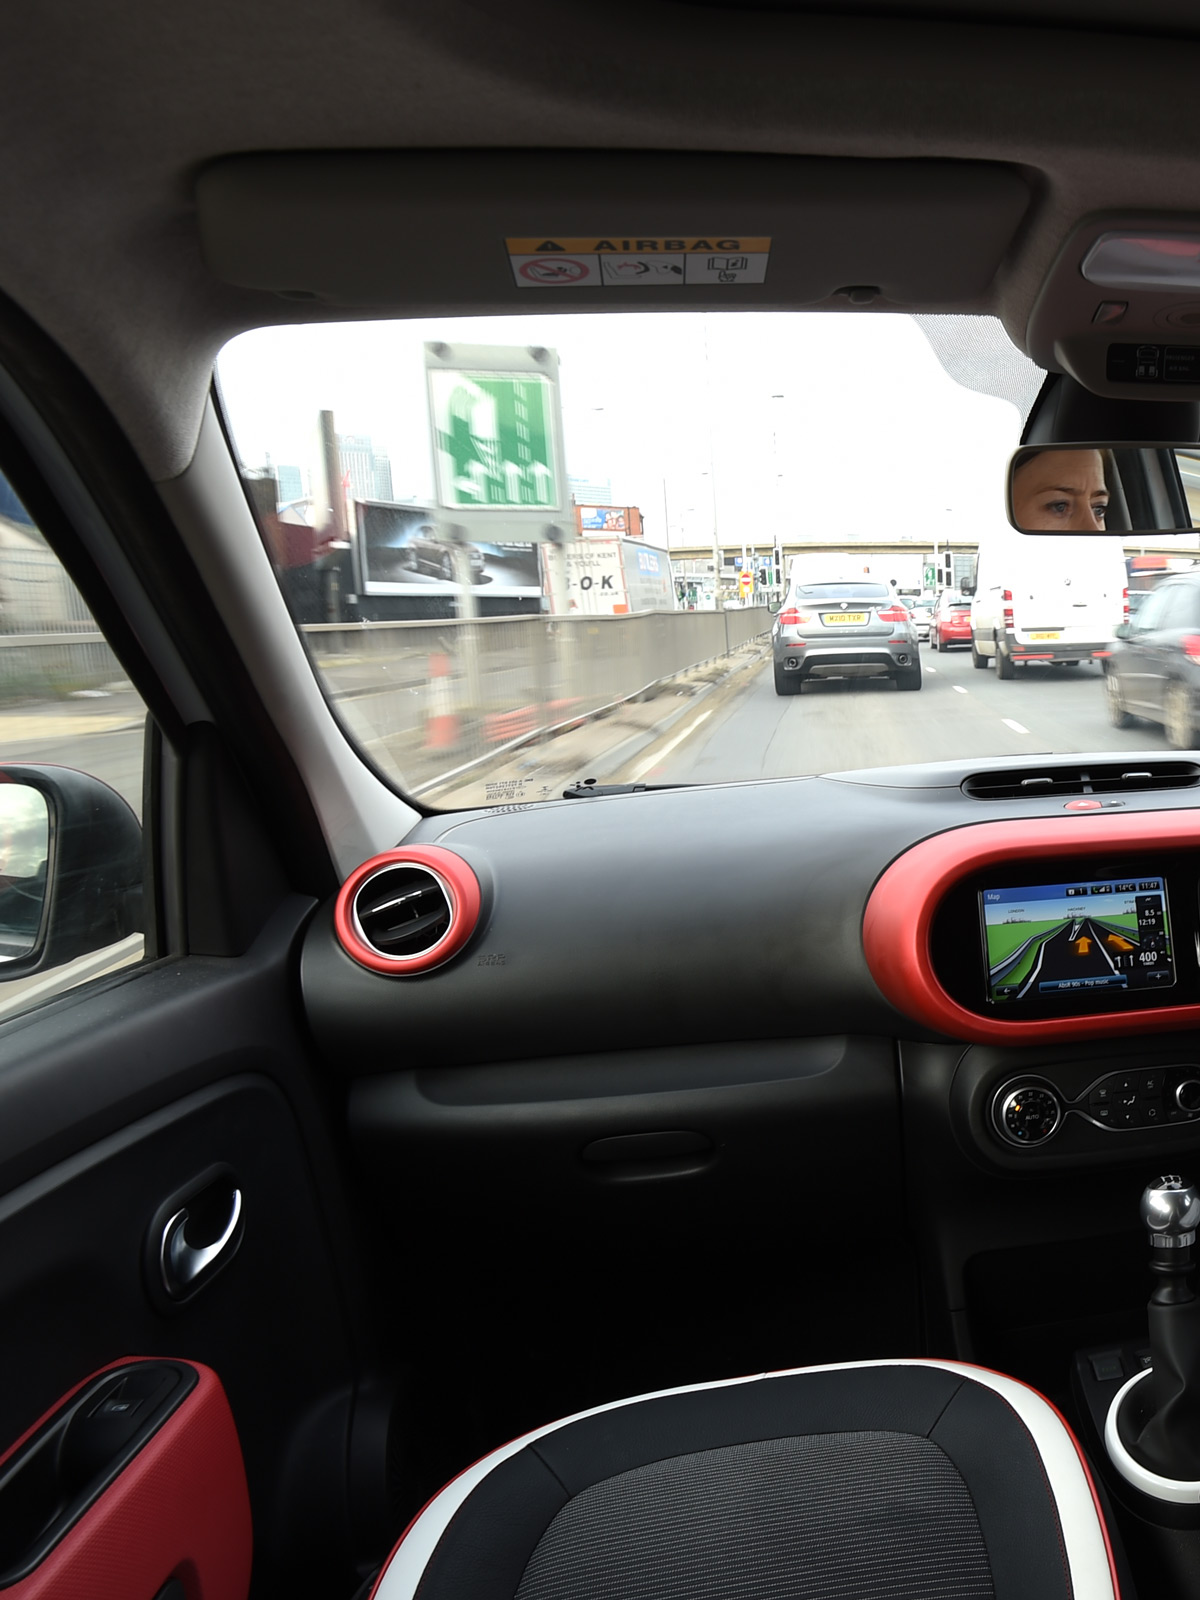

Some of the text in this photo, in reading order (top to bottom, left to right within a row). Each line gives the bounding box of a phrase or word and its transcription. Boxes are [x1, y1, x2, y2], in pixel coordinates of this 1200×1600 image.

[593, 240, 741, 251] AIRBAG
[1118, 883, 1134, 891] 14°C
[987, 893, 1001, 901] Map
[1138, 918, 1156, 926] 12:19
[1139, 951, 1158, 962] 400
[1084, 979, 1095, 987] Pop
